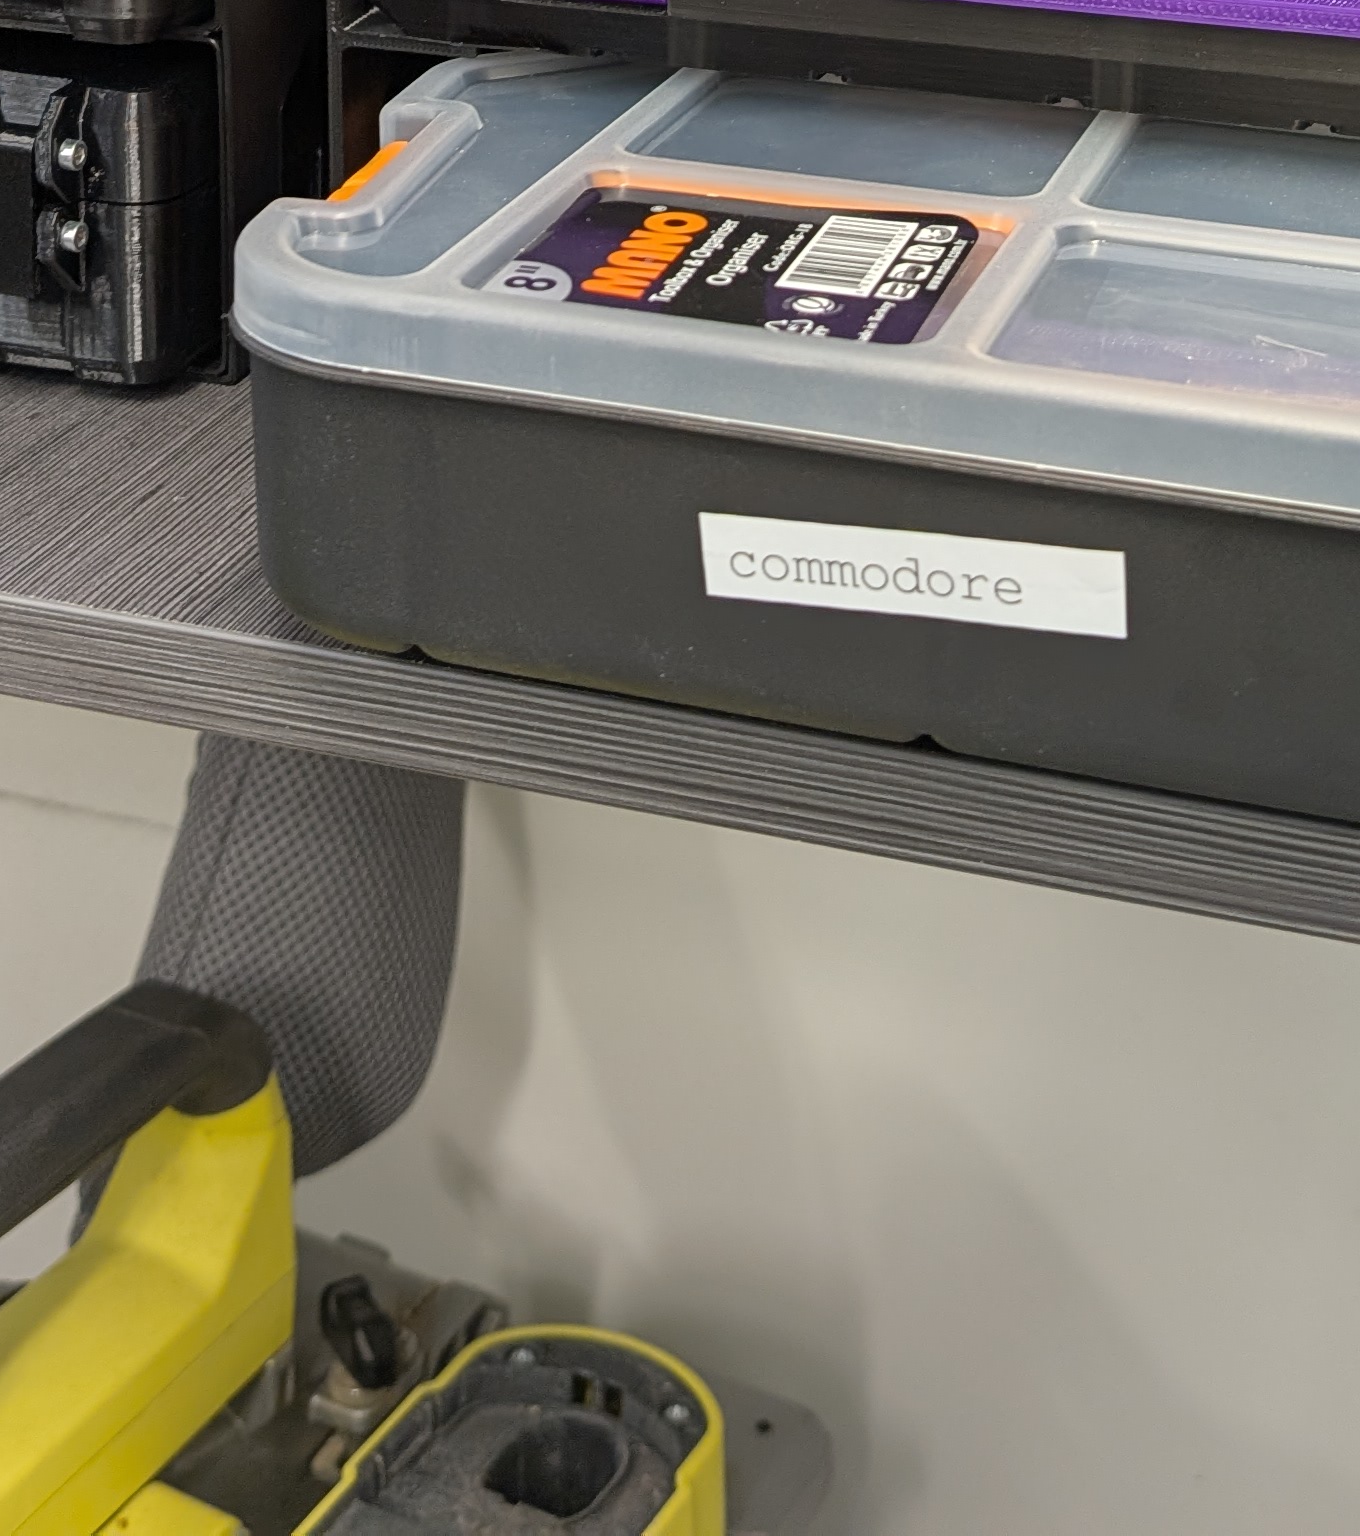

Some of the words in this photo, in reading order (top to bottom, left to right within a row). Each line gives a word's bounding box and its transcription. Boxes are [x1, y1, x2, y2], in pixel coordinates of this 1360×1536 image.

[580, 211, 709, 301] MANO
[689, 218, 741, 258] Organiser
[705, 232, 770, 286] Organiser
[647, 266, 698, 303] Toolbox
[682, 258, 705, 267] &
[729, 550, 1024, 606] commodore
